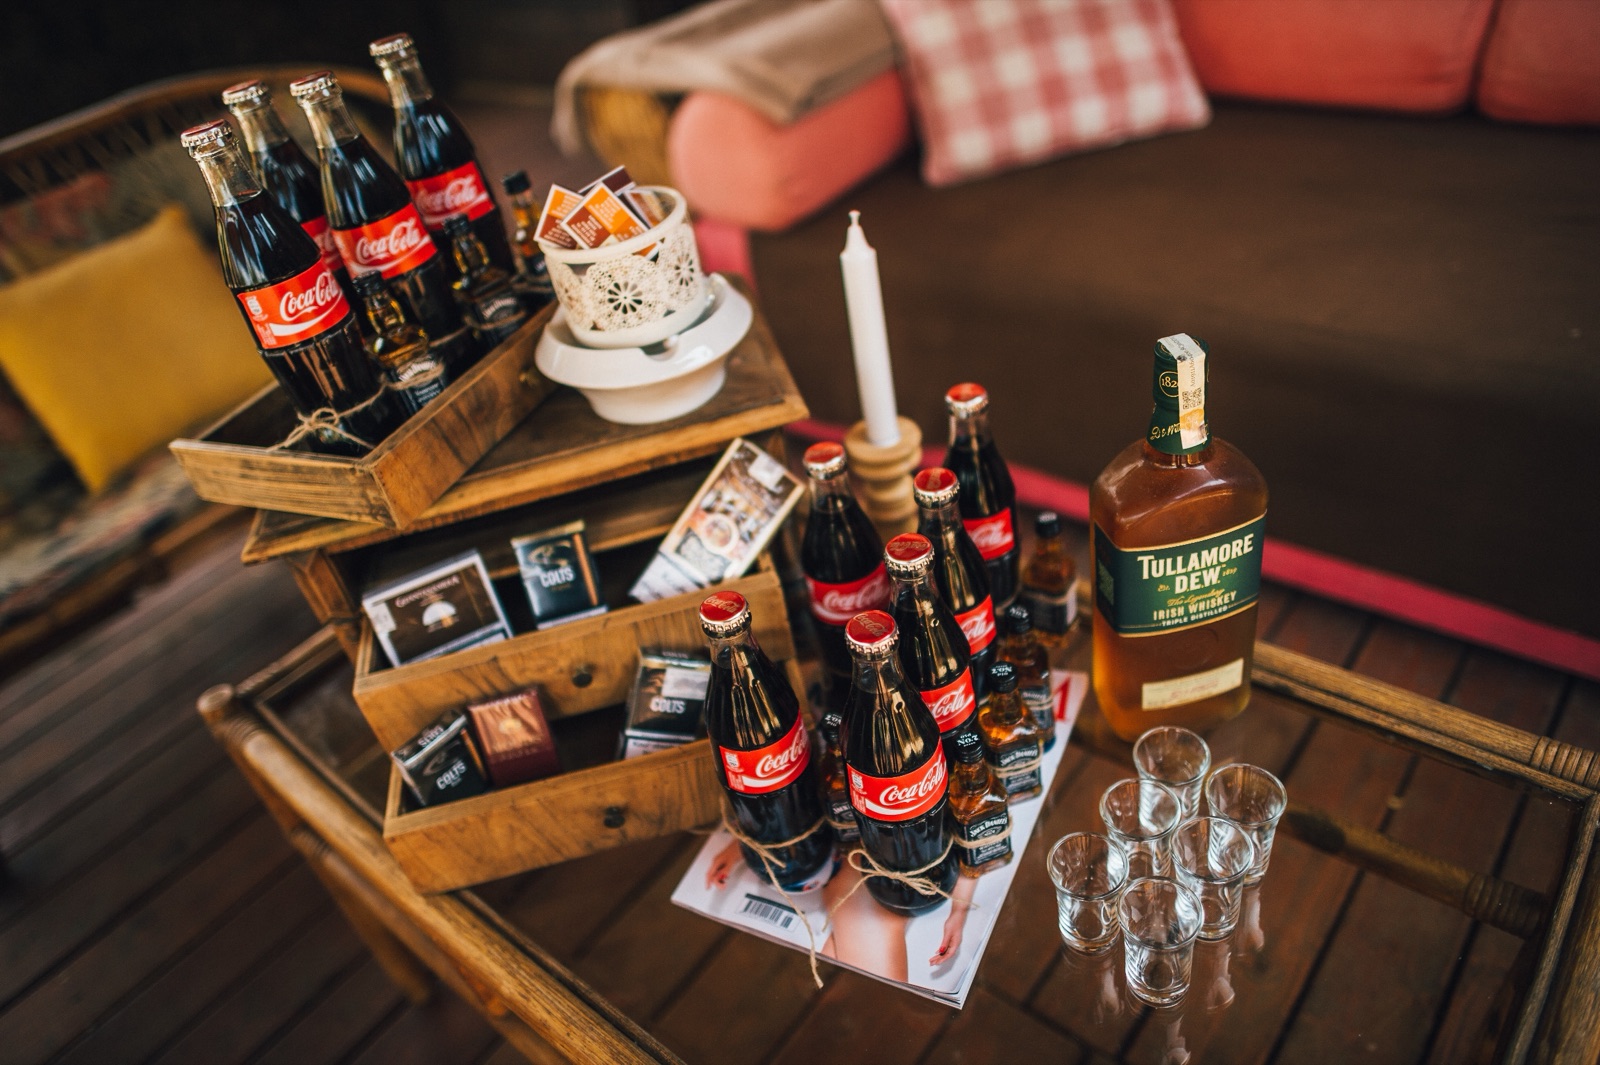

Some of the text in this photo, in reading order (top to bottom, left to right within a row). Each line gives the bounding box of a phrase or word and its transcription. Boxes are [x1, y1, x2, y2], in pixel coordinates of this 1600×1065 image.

[356, 217, 419, 264] Coca-Cola
[1161, 376, 1178, 388] 182
[1137, 533, 1254, 580] TULLAMORE
[540, 566, 574, 588] COLTS
[1153, 590, 1237, 621] IRISH WHISKEY
[1161, 605, 1228, 627] TRIPLE DISTILLED
[650, 696, 686, 714] COLTS
[436, 760, 467, 791] COLTS
[879, 753, 944, 807] Coca-Cola
